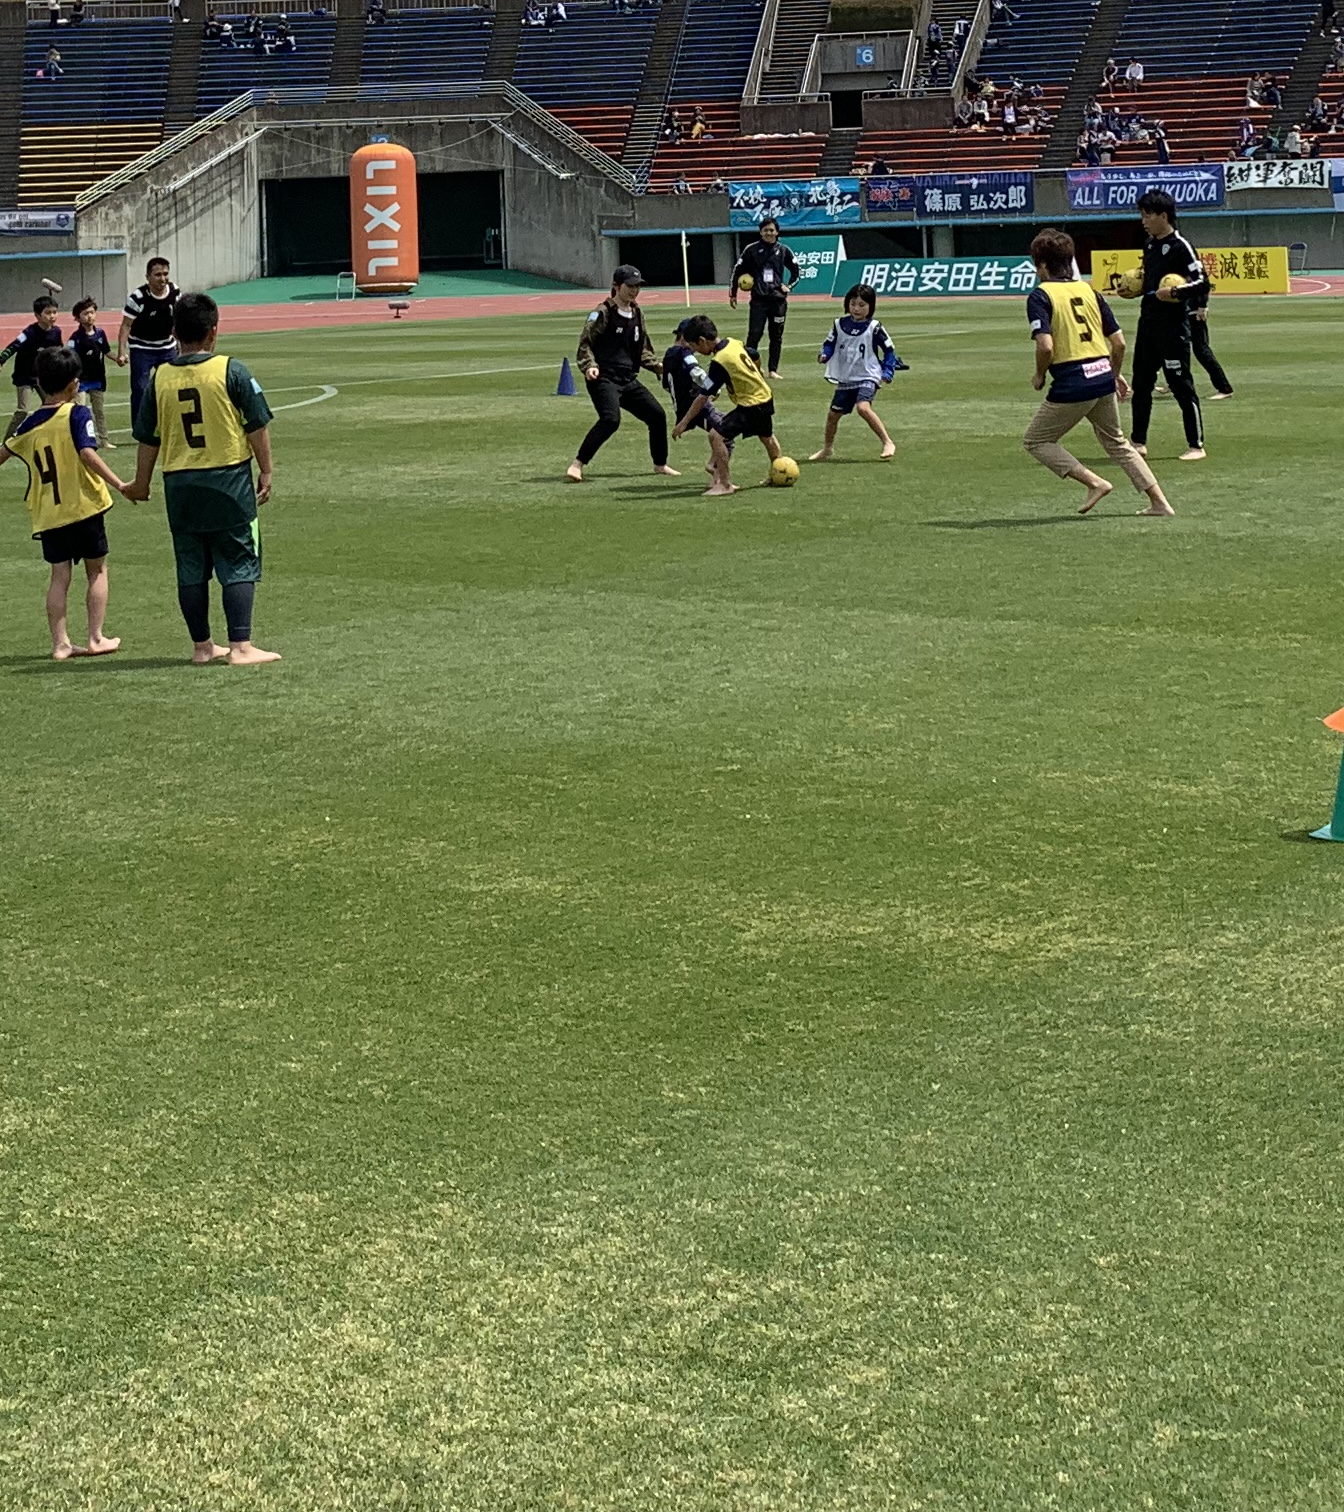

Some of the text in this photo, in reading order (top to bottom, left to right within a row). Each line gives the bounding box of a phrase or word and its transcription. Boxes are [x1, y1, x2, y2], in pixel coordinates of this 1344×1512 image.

[862, 49, 874, 63] 6
[924, 188, 962, 212] 篠原
[970, 185, 1026, 211] 弘次郎
[1074, 187, 1101, 206] ALL
[1108, 185, 1139, 205] FOR
[364, 160, 401, 276] LIXIL
[859, 260, 1038, 294] 明治安田生命
[1070, 296, 1093, 342] 5
[859, 343, 866, 359] 9
[177, 387, 206, 449] 2
[34, 445, 61, 506] 4
